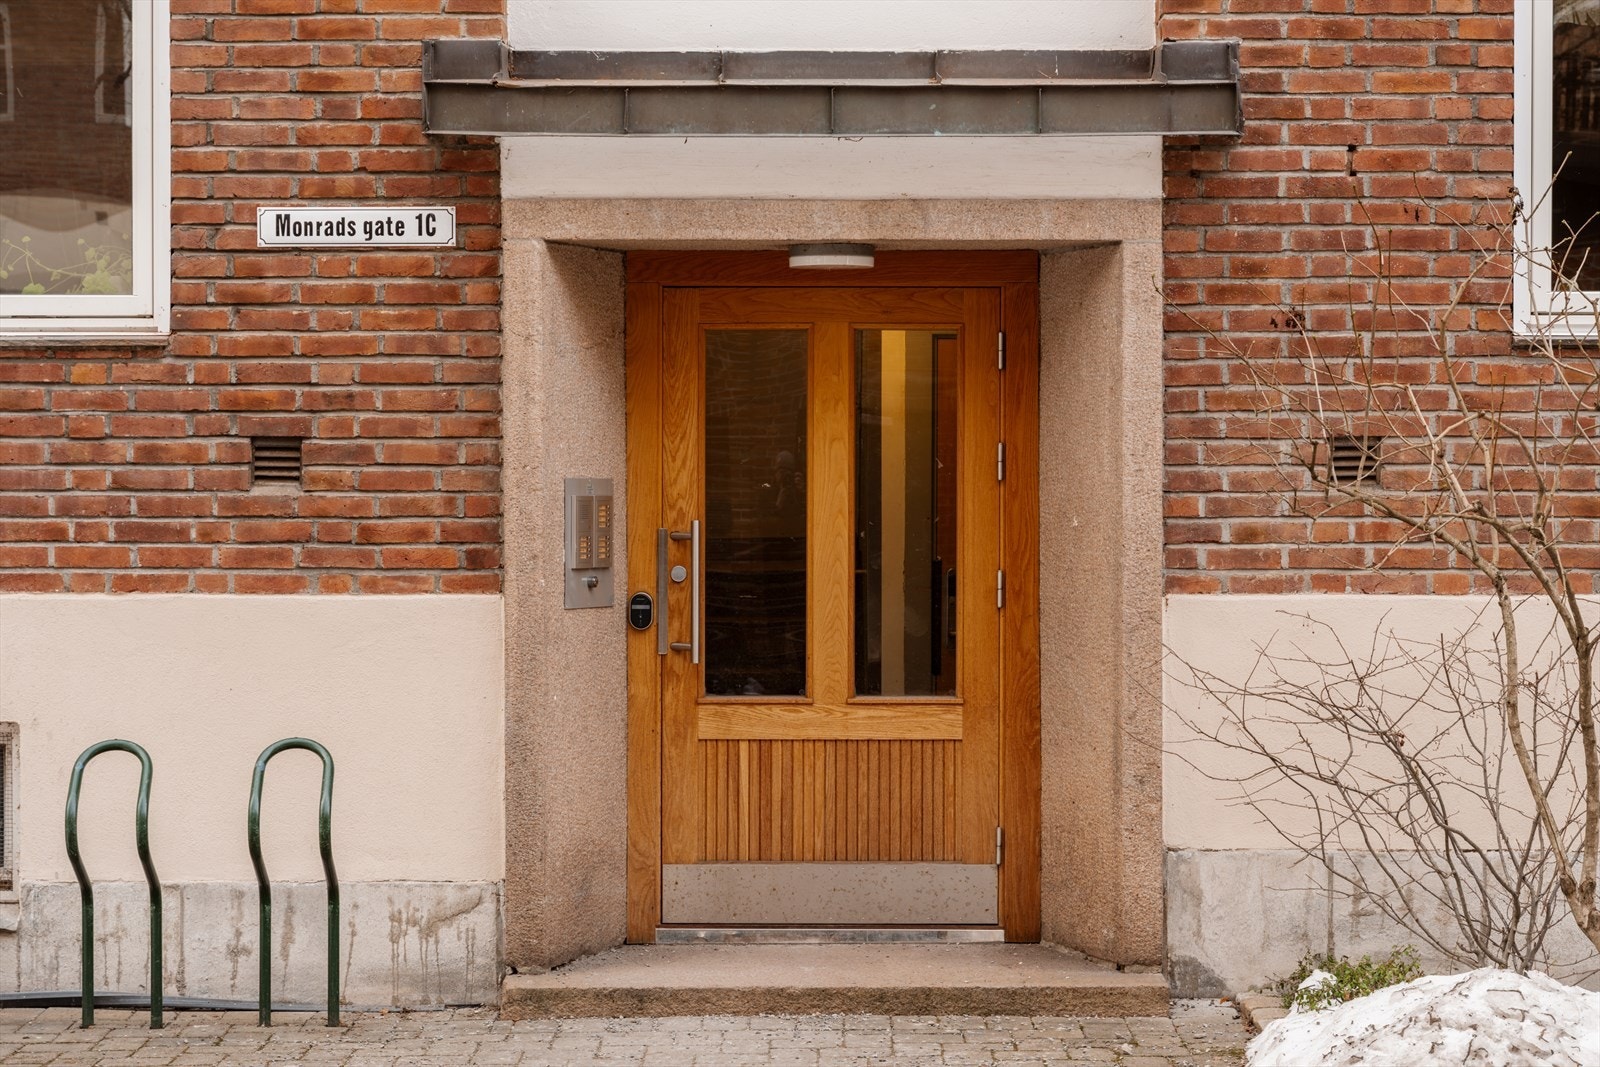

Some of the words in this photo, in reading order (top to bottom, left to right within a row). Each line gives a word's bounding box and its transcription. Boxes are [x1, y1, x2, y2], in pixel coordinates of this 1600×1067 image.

[275, 213, 357, 237] Monrads
[363, 216, 405, 241] gate
[414, 213, 437, 237] 1C
